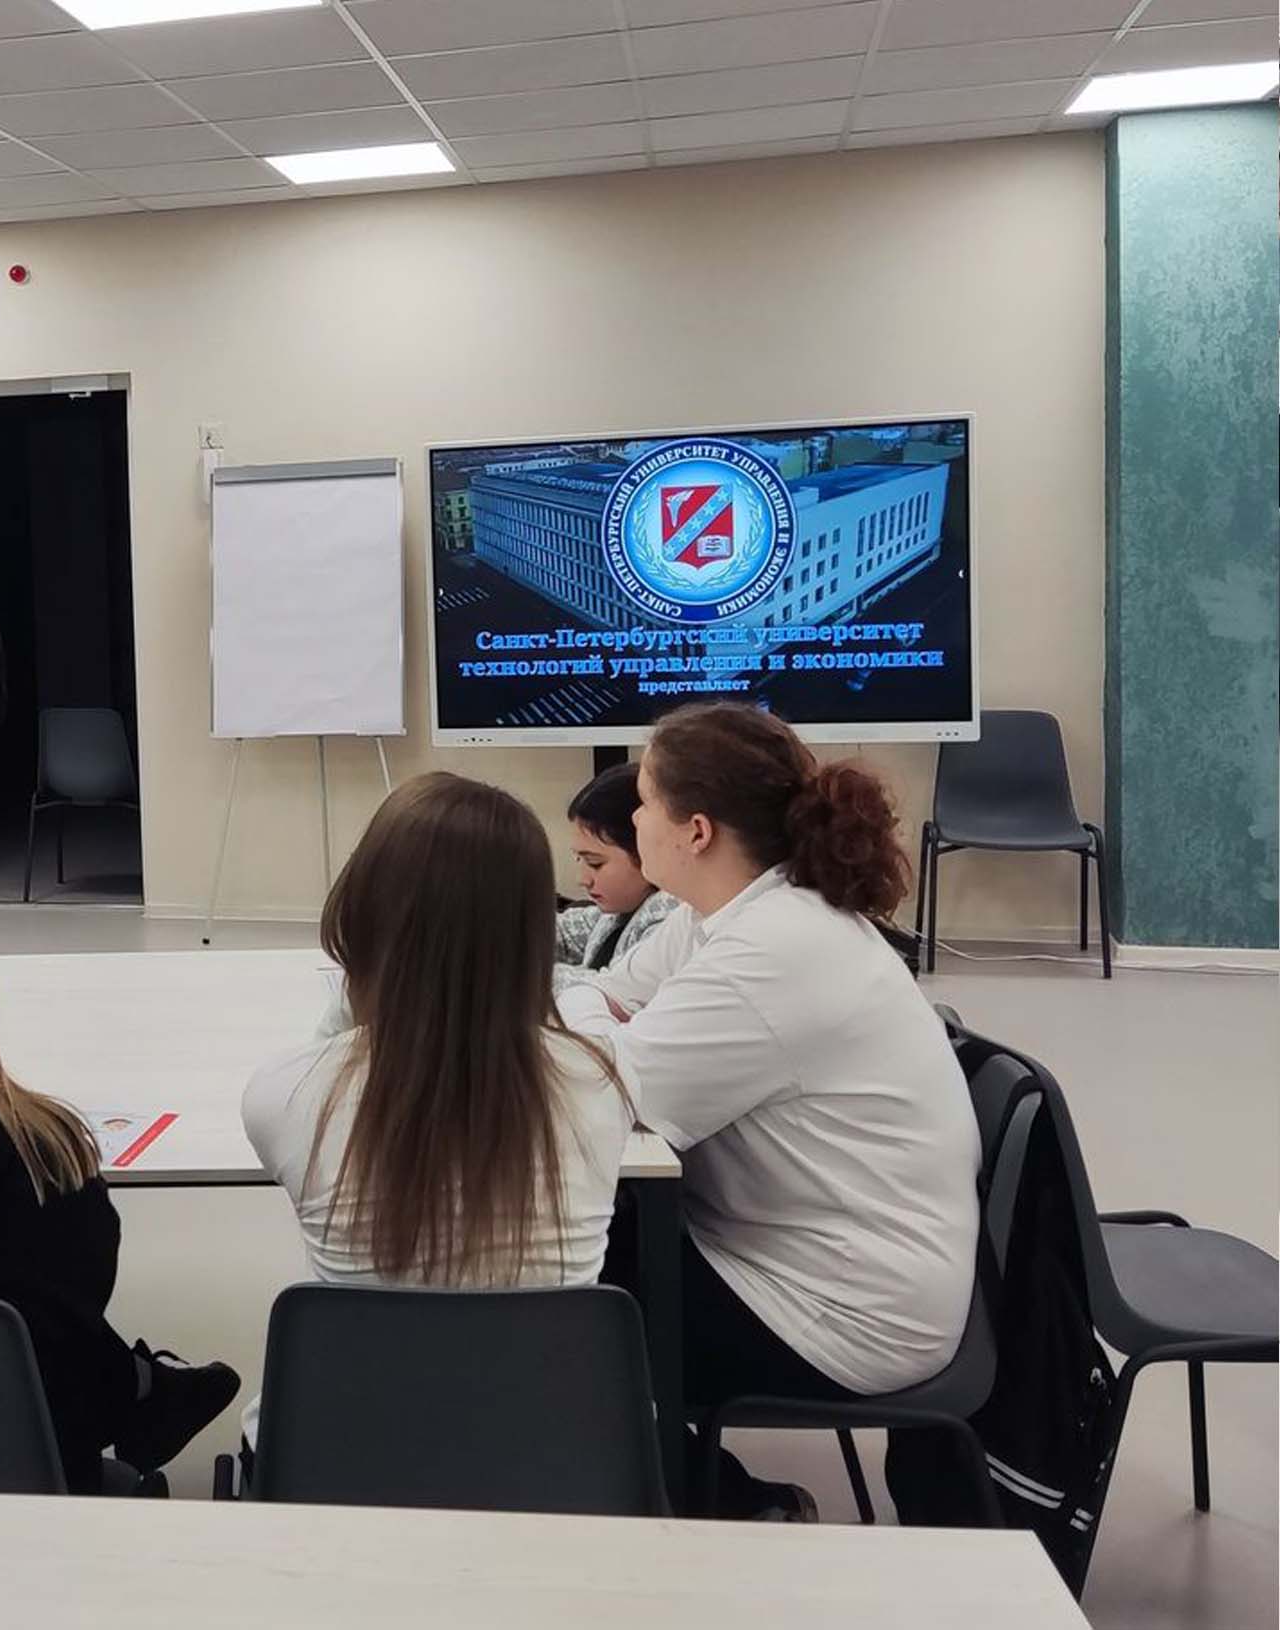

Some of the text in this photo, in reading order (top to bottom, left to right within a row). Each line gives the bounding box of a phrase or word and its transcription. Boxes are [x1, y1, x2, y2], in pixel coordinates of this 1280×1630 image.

[608, 445, 790, 616] САНКТ-ПЕТЕРБУРГСКИЙ УНИВЕРСИТЕТ УПРАВЛЕНИЯ И ЭКОНОМИКИ
[476, 622, 924, 651] Санкт-Петербургский университет
[459, 650, 944, 679] технологий управления и экономики
[638, 679, 751, 696] представляет
